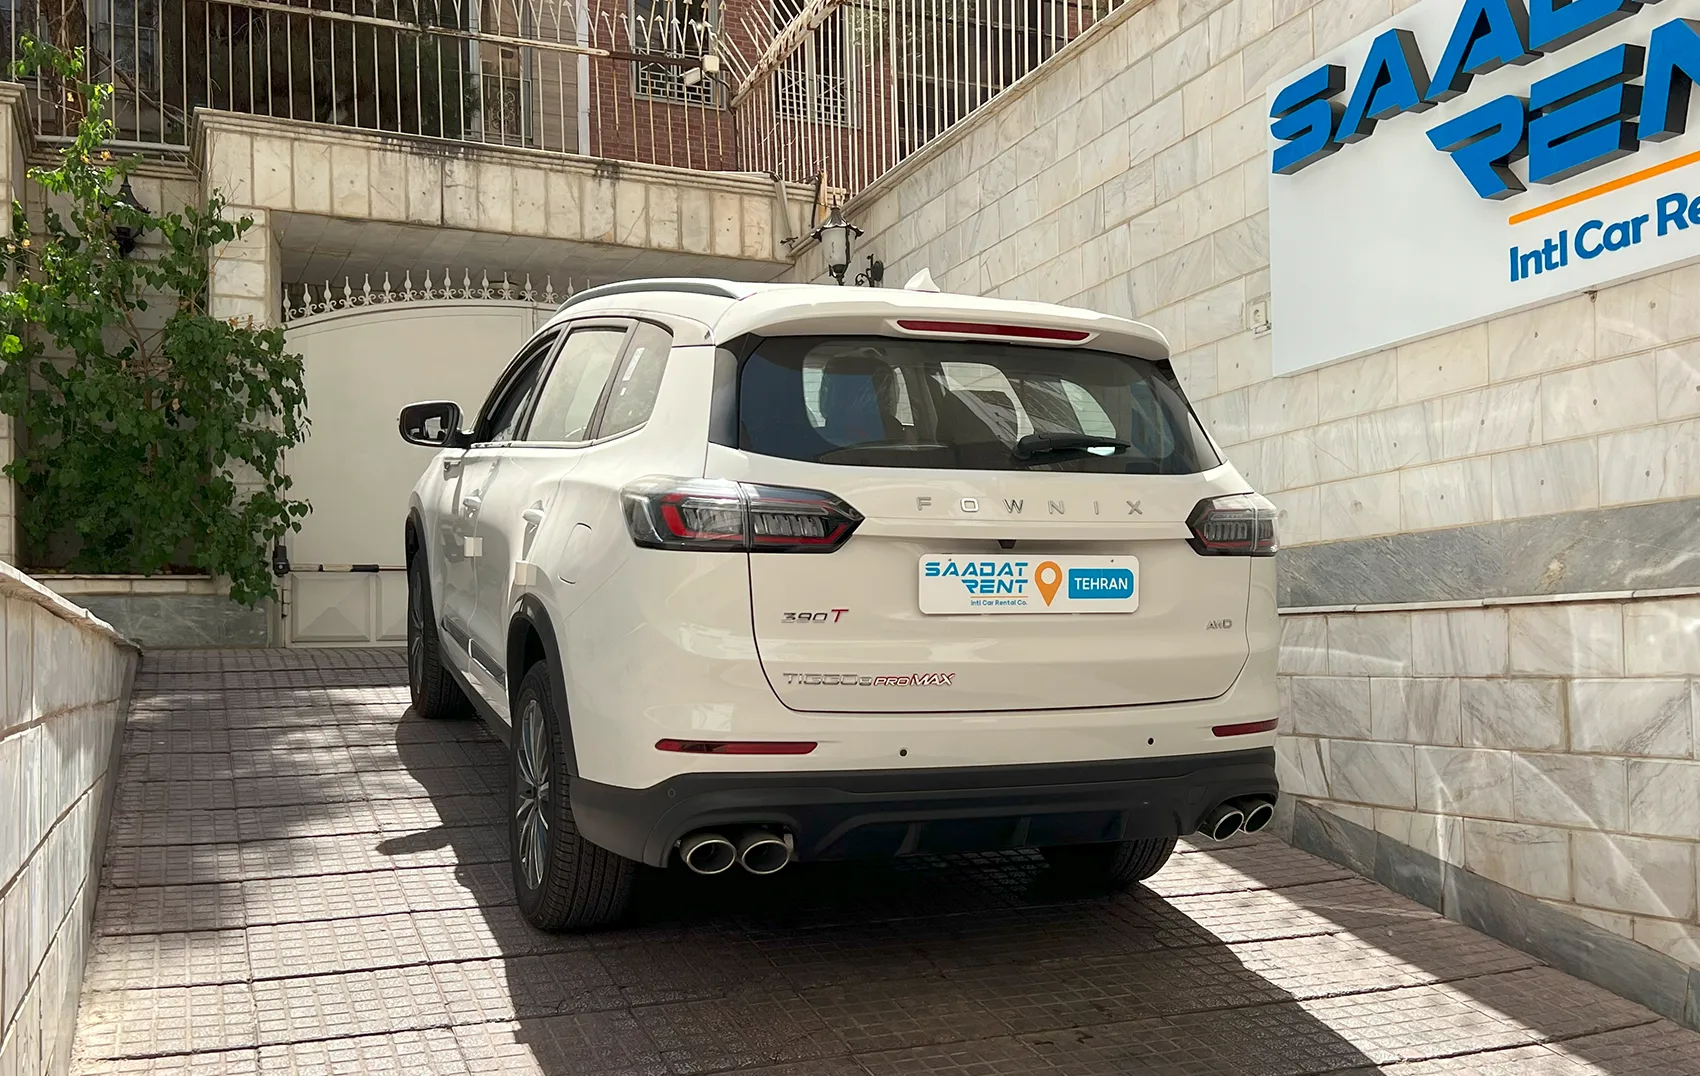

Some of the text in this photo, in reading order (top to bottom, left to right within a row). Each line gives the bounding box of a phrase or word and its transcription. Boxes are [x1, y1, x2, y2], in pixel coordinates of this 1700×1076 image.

[1510, 229, 1568, 282] Intl
[1574, 219, 1650, 260] Car
[916, 496, 1143, 516] FOWNIX
[925, 561, 1029, 577] SAADAT
[961, 578, 1029, 594] RENT
[1074, 577, 1129, 590] TEHRAN
